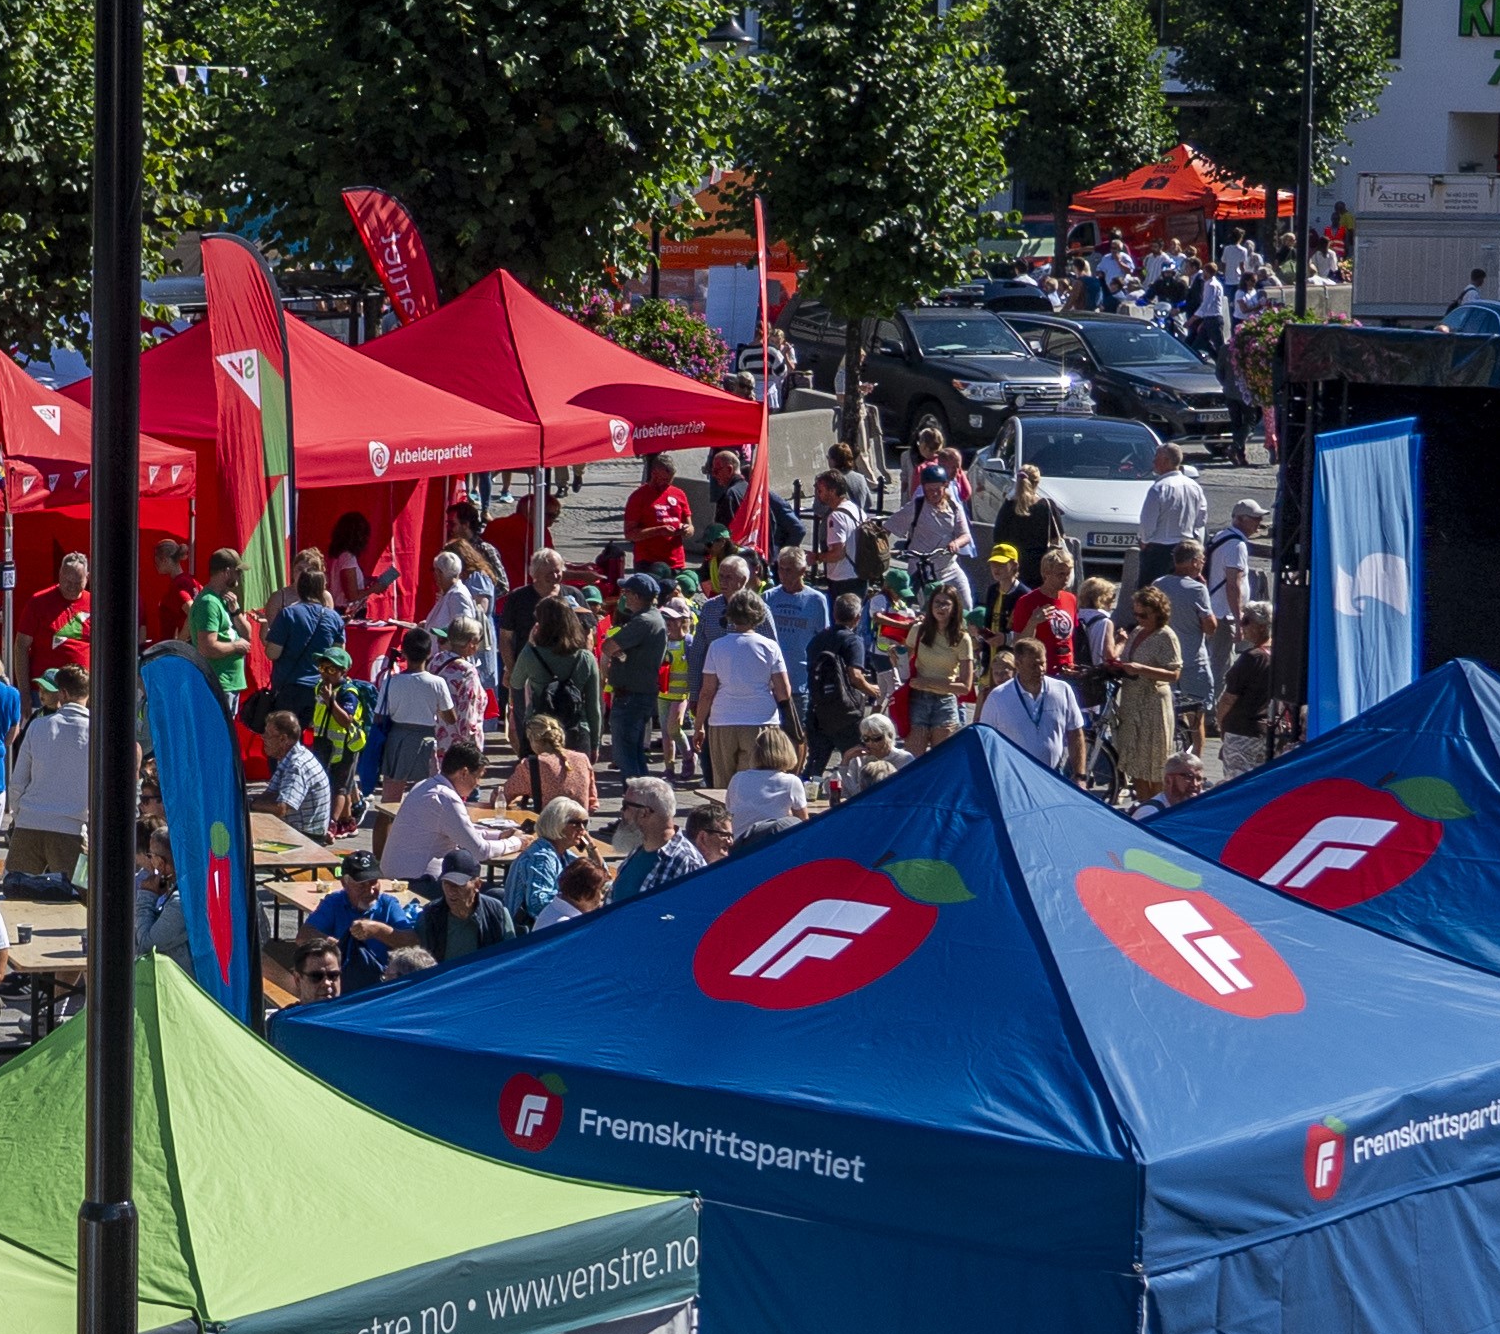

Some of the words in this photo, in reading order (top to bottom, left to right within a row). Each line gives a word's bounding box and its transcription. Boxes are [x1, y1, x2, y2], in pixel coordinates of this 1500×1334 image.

[393, 443, 473, 465] Arbeiderpartiet
[632, 420, 706, 441] Arbeiderpartiet
[578, 1106, 867, 1184] Fremskrittspartiet
[487, 1232, 700, 1322] www.venstre.no
